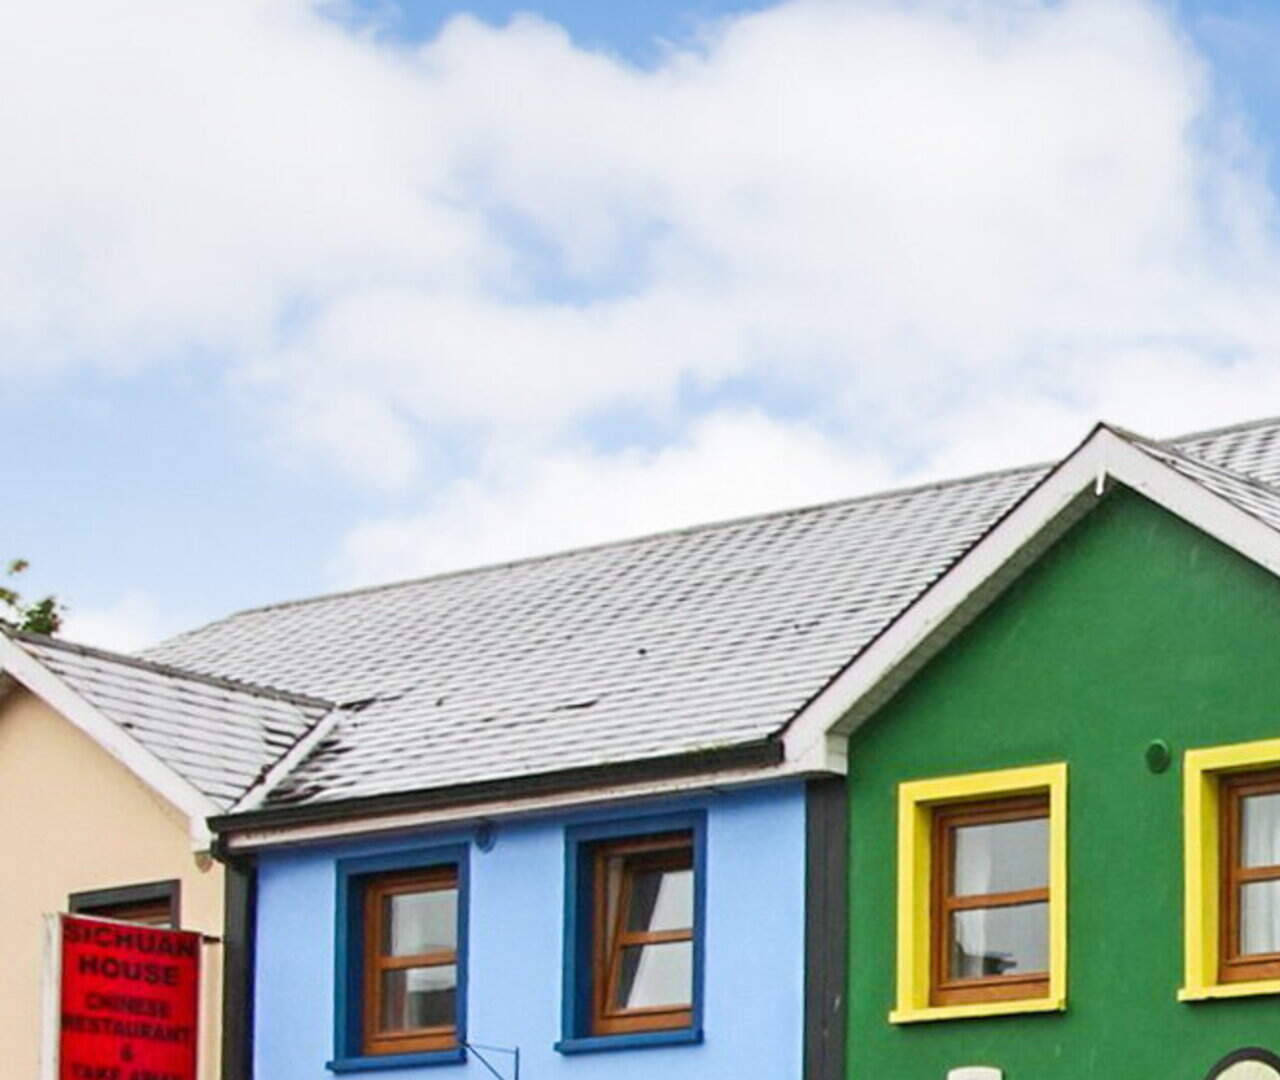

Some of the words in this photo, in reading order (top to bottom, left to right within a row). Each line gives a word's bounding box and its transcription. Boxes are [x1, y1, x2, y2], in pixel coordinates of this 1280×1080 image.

[63, 922, 199, 957] SICHUAN
[78, 955, 180, 986] HOUSE
[85, 992, 171, 1018] CHINESE
[61, 1012, 192, 1042] RESTAURANT
